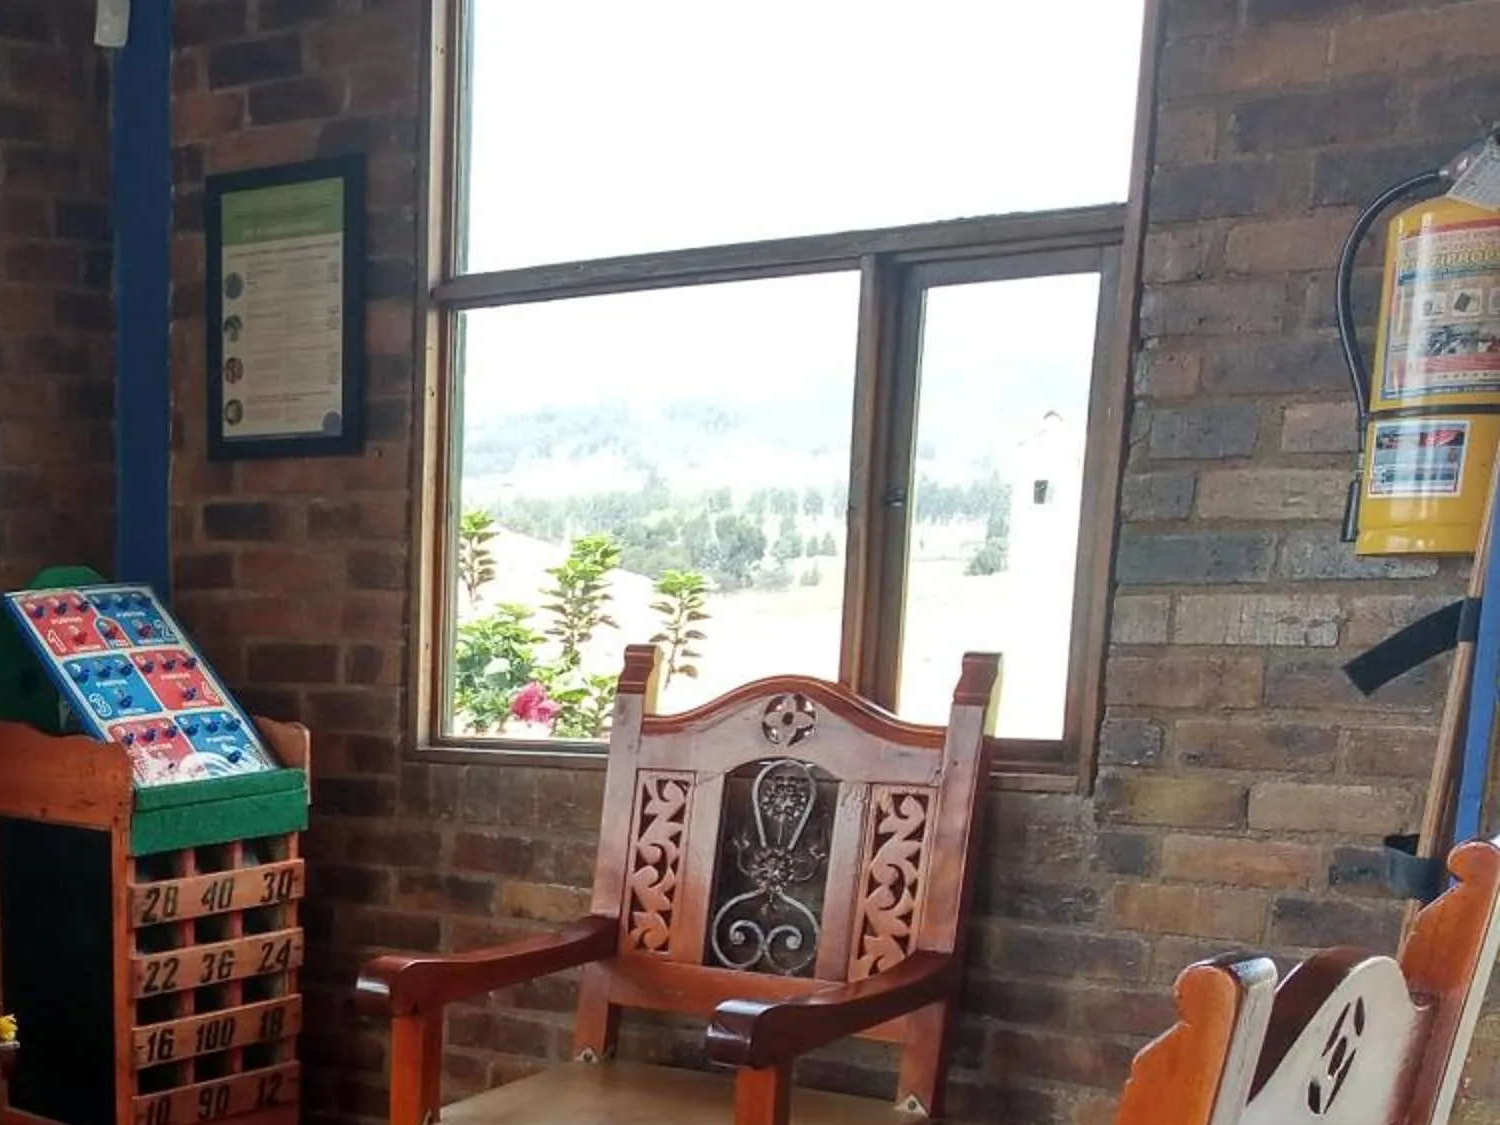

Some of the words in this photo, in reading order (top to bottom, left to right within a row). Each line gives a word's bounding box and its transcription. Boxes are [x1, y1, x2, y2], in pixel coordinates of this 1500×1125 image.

[201, 877, 235, 912] 40
[260, 869, 295, 903] 30
[143, 957, 180, 994] 22
[200, 949, 236, 983] 36
[257, 939, 292, 973] 24
[147, 1028, 175, 1063] 16
[196, 1016, 237, 1053] 100
[199, 1085, 231, 1120] 90
[256, 1073, 284, 1109] 12
